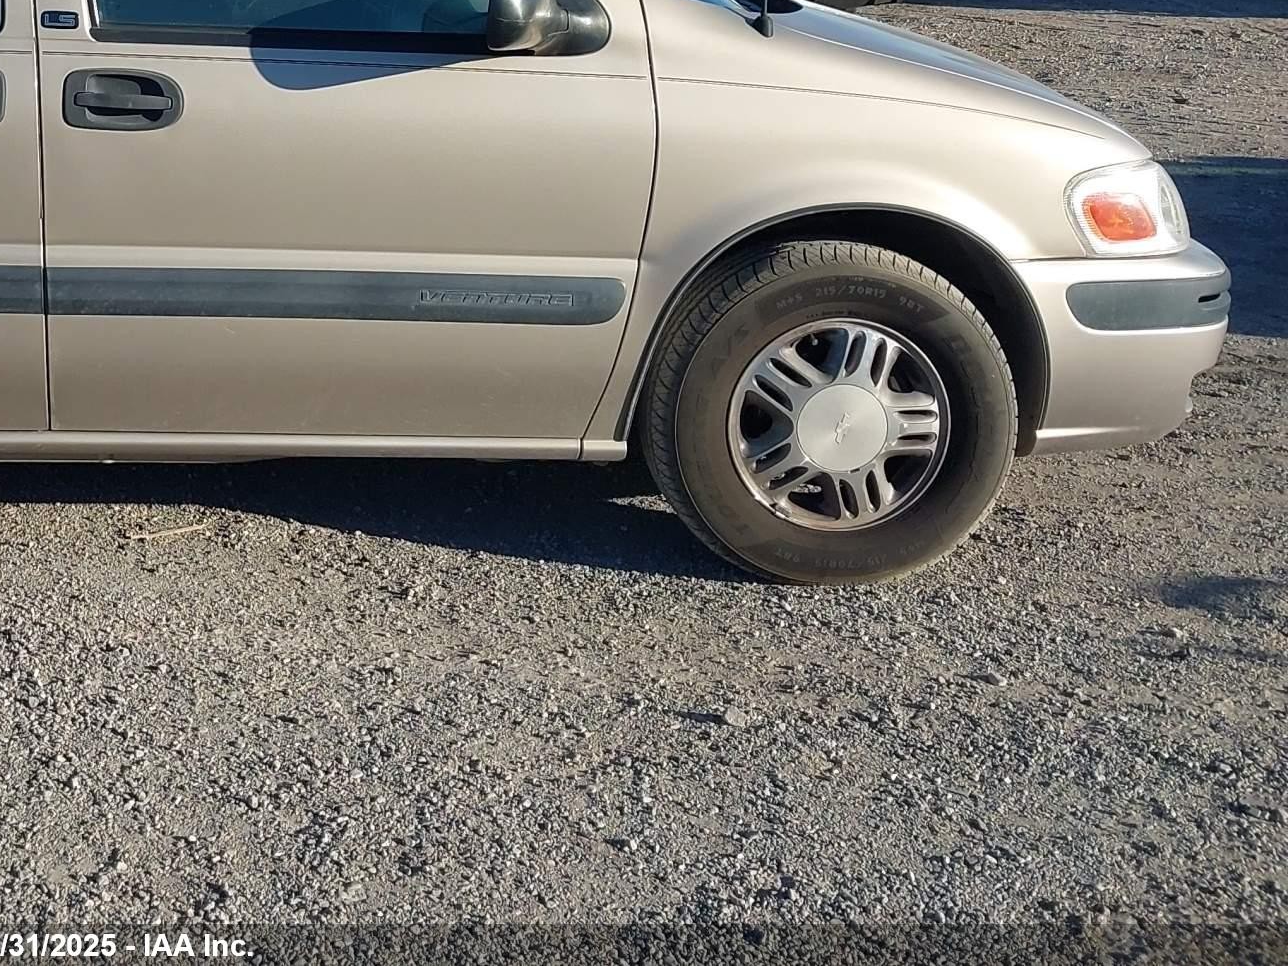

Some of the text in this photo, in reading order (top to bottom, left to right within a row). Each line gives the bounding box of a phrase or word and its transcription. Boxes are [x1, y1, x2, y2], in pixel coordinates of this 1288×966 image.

[44, 13, 76, 27] LS
[418, 289, 575, 307] VENTURE
[815, 284, 887, 298] 215/70R15
